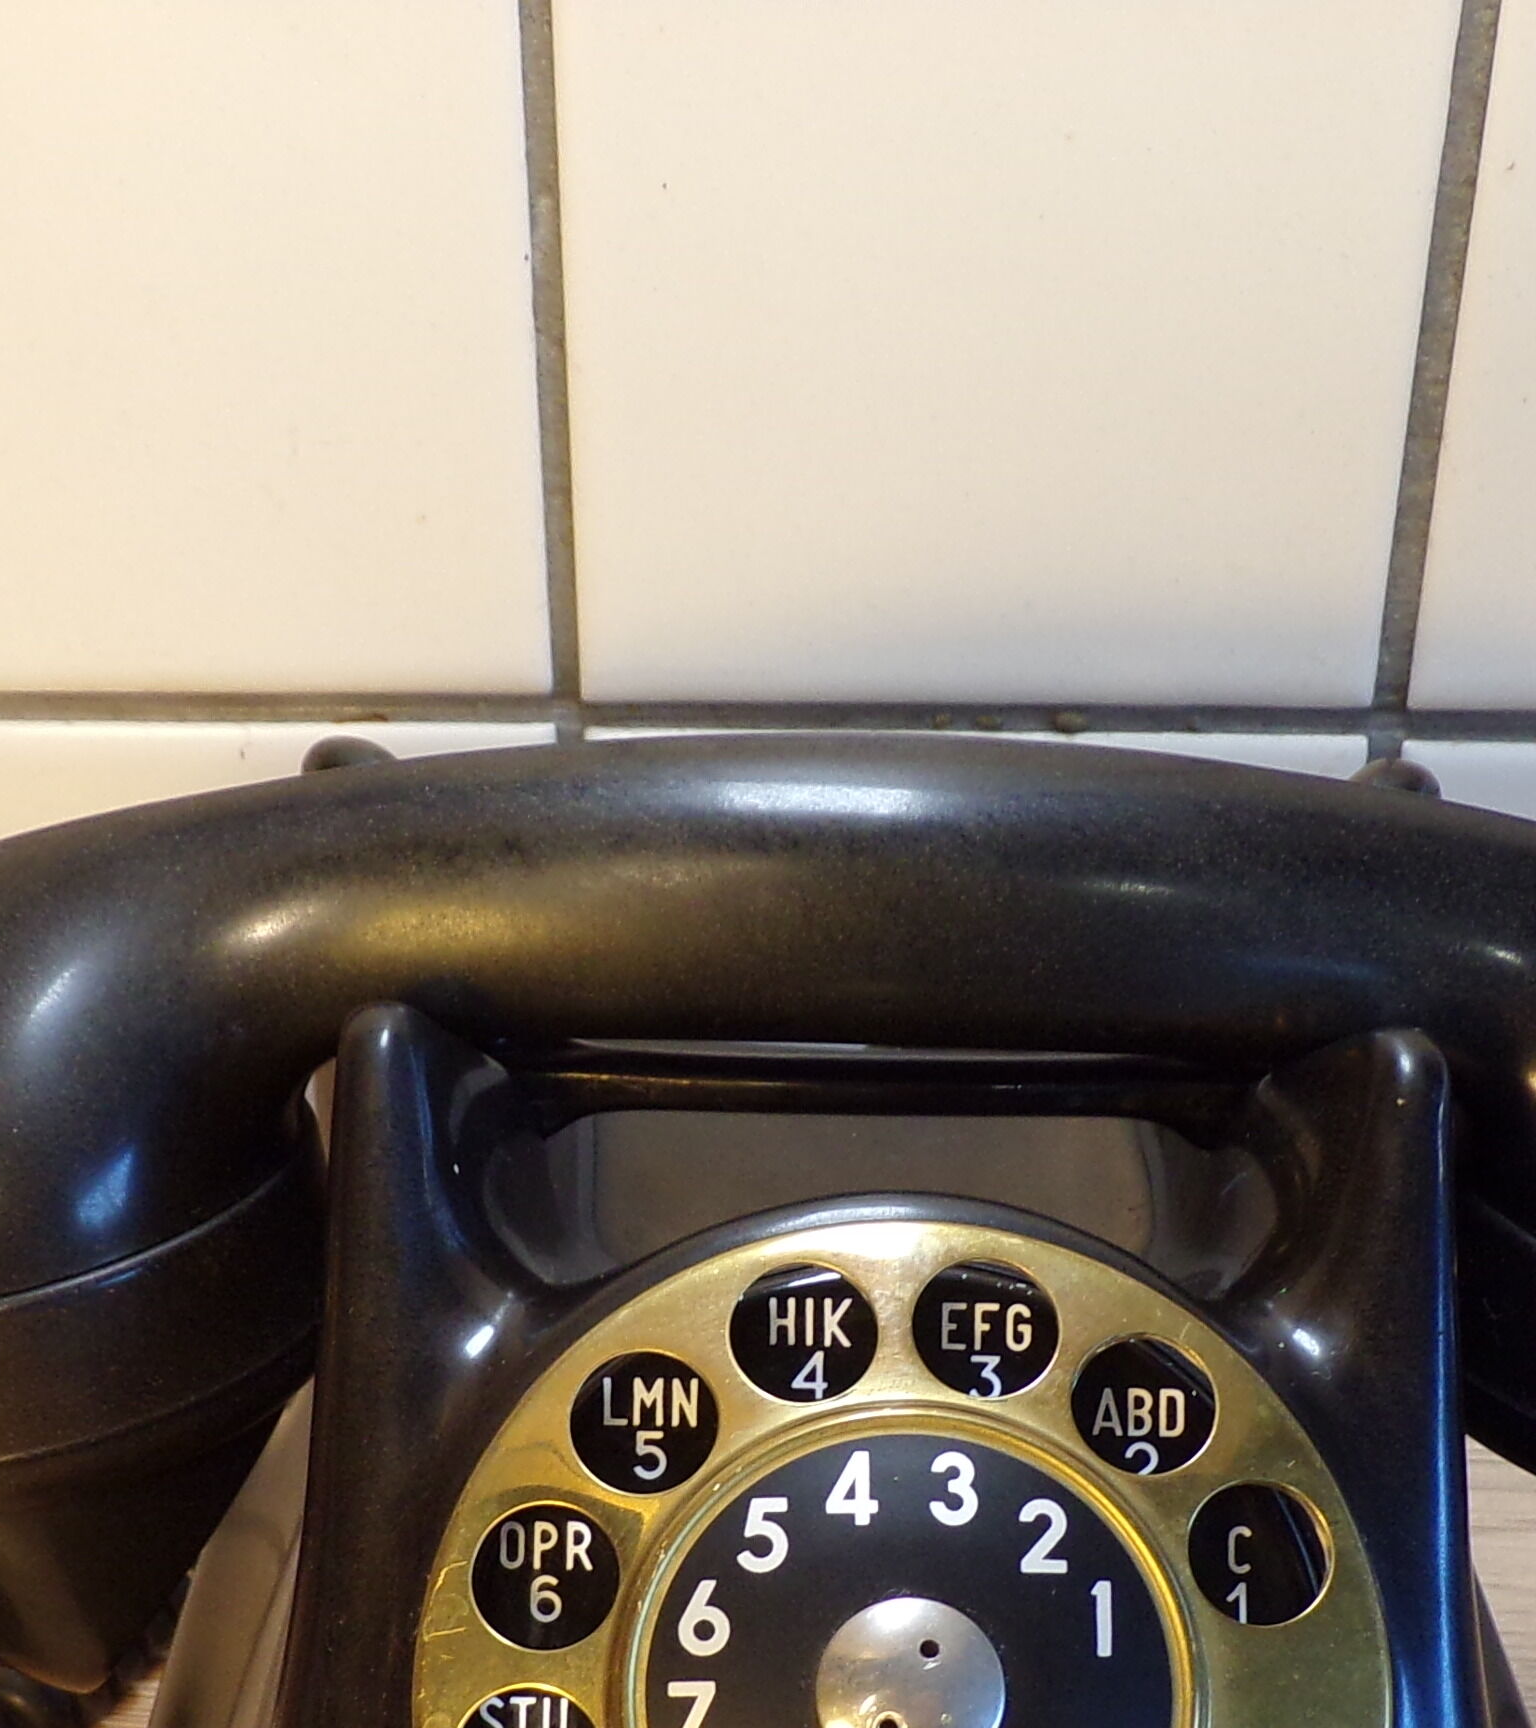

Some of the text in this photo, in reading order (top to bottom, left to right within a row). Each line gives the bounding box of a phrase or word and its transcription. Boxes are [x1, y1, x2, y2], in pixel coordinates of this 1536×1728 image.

[769, 1296, 853, 1348] HIK
[941, 1302, 1032, 1351] EFG
[792, 1350, 828, 1400] 4
[969, 1355, 1003, 1397] 3
[603, 1377, 699, 1428] LMN
[1092, 1388, 1185, 1438] ABD
[632, 1431, 667, 1480] 5
[1124, 1443, 1159, 1475] 2
[825, 1450, 879, 1526] 4
[929, 1451, 979, 1527] 3
[499, 1521, 593, 1571] OPR
[736, 1497, 789, 1573] 5
[1018, 1499, 1068, 1573] 2
[1227, 1525, 1253, 1574] C
[529, 1574, 562, 1623] 6
[678, 1579, 731, 1657] 6
[1090, 1580, 1112, 1657] 1
[1226, 1582, 1248, 1624] 1
